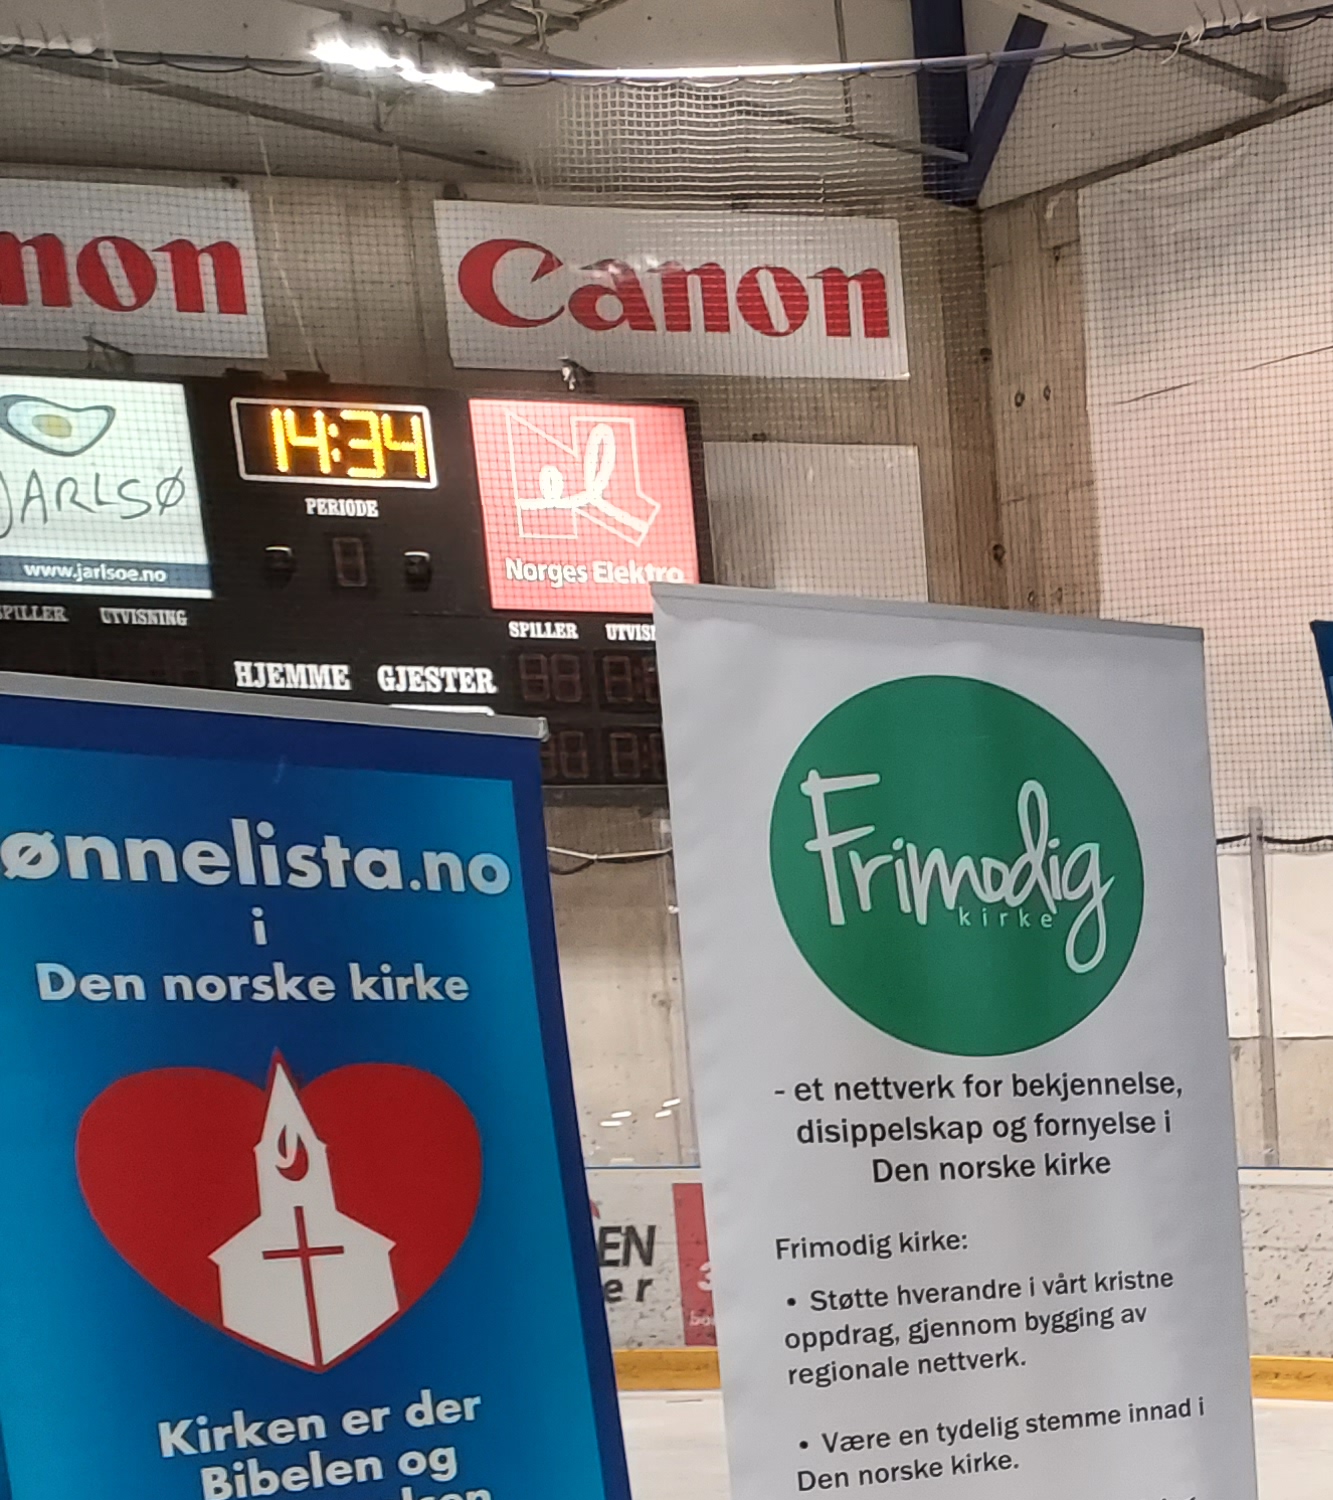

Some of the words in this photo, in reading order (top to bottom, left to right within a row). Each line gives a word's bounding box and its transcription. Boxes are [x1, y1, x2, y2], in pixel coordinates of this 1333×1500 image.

[457, 239, 891, 337] Canon
[270, 406, 428, 479] 14:34
[304, 498, 380, 518] PERIODE
[23, 563, 167, 583] www.jarlsoe.no
[505, 557, 588, 588] Norges
[593, 559, 685, 585] Elektro
[99, 607, 188, 627] UTVISNING
[508, 620, 579, 641] SPILLER
[233, 660, 352, 692] HJEMME
[377, 663, 498, 695] GJESTER
[0, 817, 511, 895] ønnelista.no
[801, 769, 1116, 974] Frimodig
[251, 907, 268, 946] i
[958, 906, 1056, 929] kirke
[35, 962, 145, 1002] Den
[163, 961, 336, 1002] norske
[349, 962, 470, 1002] kirke
[793, 1078, 824, 1102] et
[834, 1075, 955, 1101] nettverk
[963, 1073, 1003, 1098] for
[1011, 1071, 1183, 1105] bekjennelse,
[796, 1113, 983, 1149] disippelskap
[992, 1115, 1028, 1143] og
[1034, 1111, 1157, 1143] fornyelse
[872, 1157, 929, 1183] Den
[938, 1154, 1036, 1180] norske
[1044, 1151, 1112, 1177] kirke
[775, 1232, 893, 1260] Frimodig
[898, 1230, 969, 1254] kirke:
[810, 1285, 889, 1312] Støtte
[896, 1275, 1022, 1307] hverandre
[1042, 1271, 1088, 1296] vårt
[1094, 1268, 1175, 1293] kristne
[784, 1321, 902, 1354] oppdrag,
[908, 1315, 1018, 1346] gjennom
[1024, 1306, 1115, 1336] bygging
[788, 1356, 910, 1388] regionale
[917, 1347, 1027, 1376] nettverk.
[157, 1409, 327, 1459] Kirken
[341, 1404, 391, 1436] er
[404, 1388, 482, 1429] der
[821, 1430, 891, 1453] Være
[936, 1414, 1020, 1447] tydelig
[1025, 1406, 1122, 1435] stemme
[1128, 1398, 1192, 1424] innad
[398, 1445, 458, 1484] og
[797, 1469, 850, 1492] Den
[858, 1458, 944, 1487] norske
[951, 1452, 1020, 1476] kirke.
